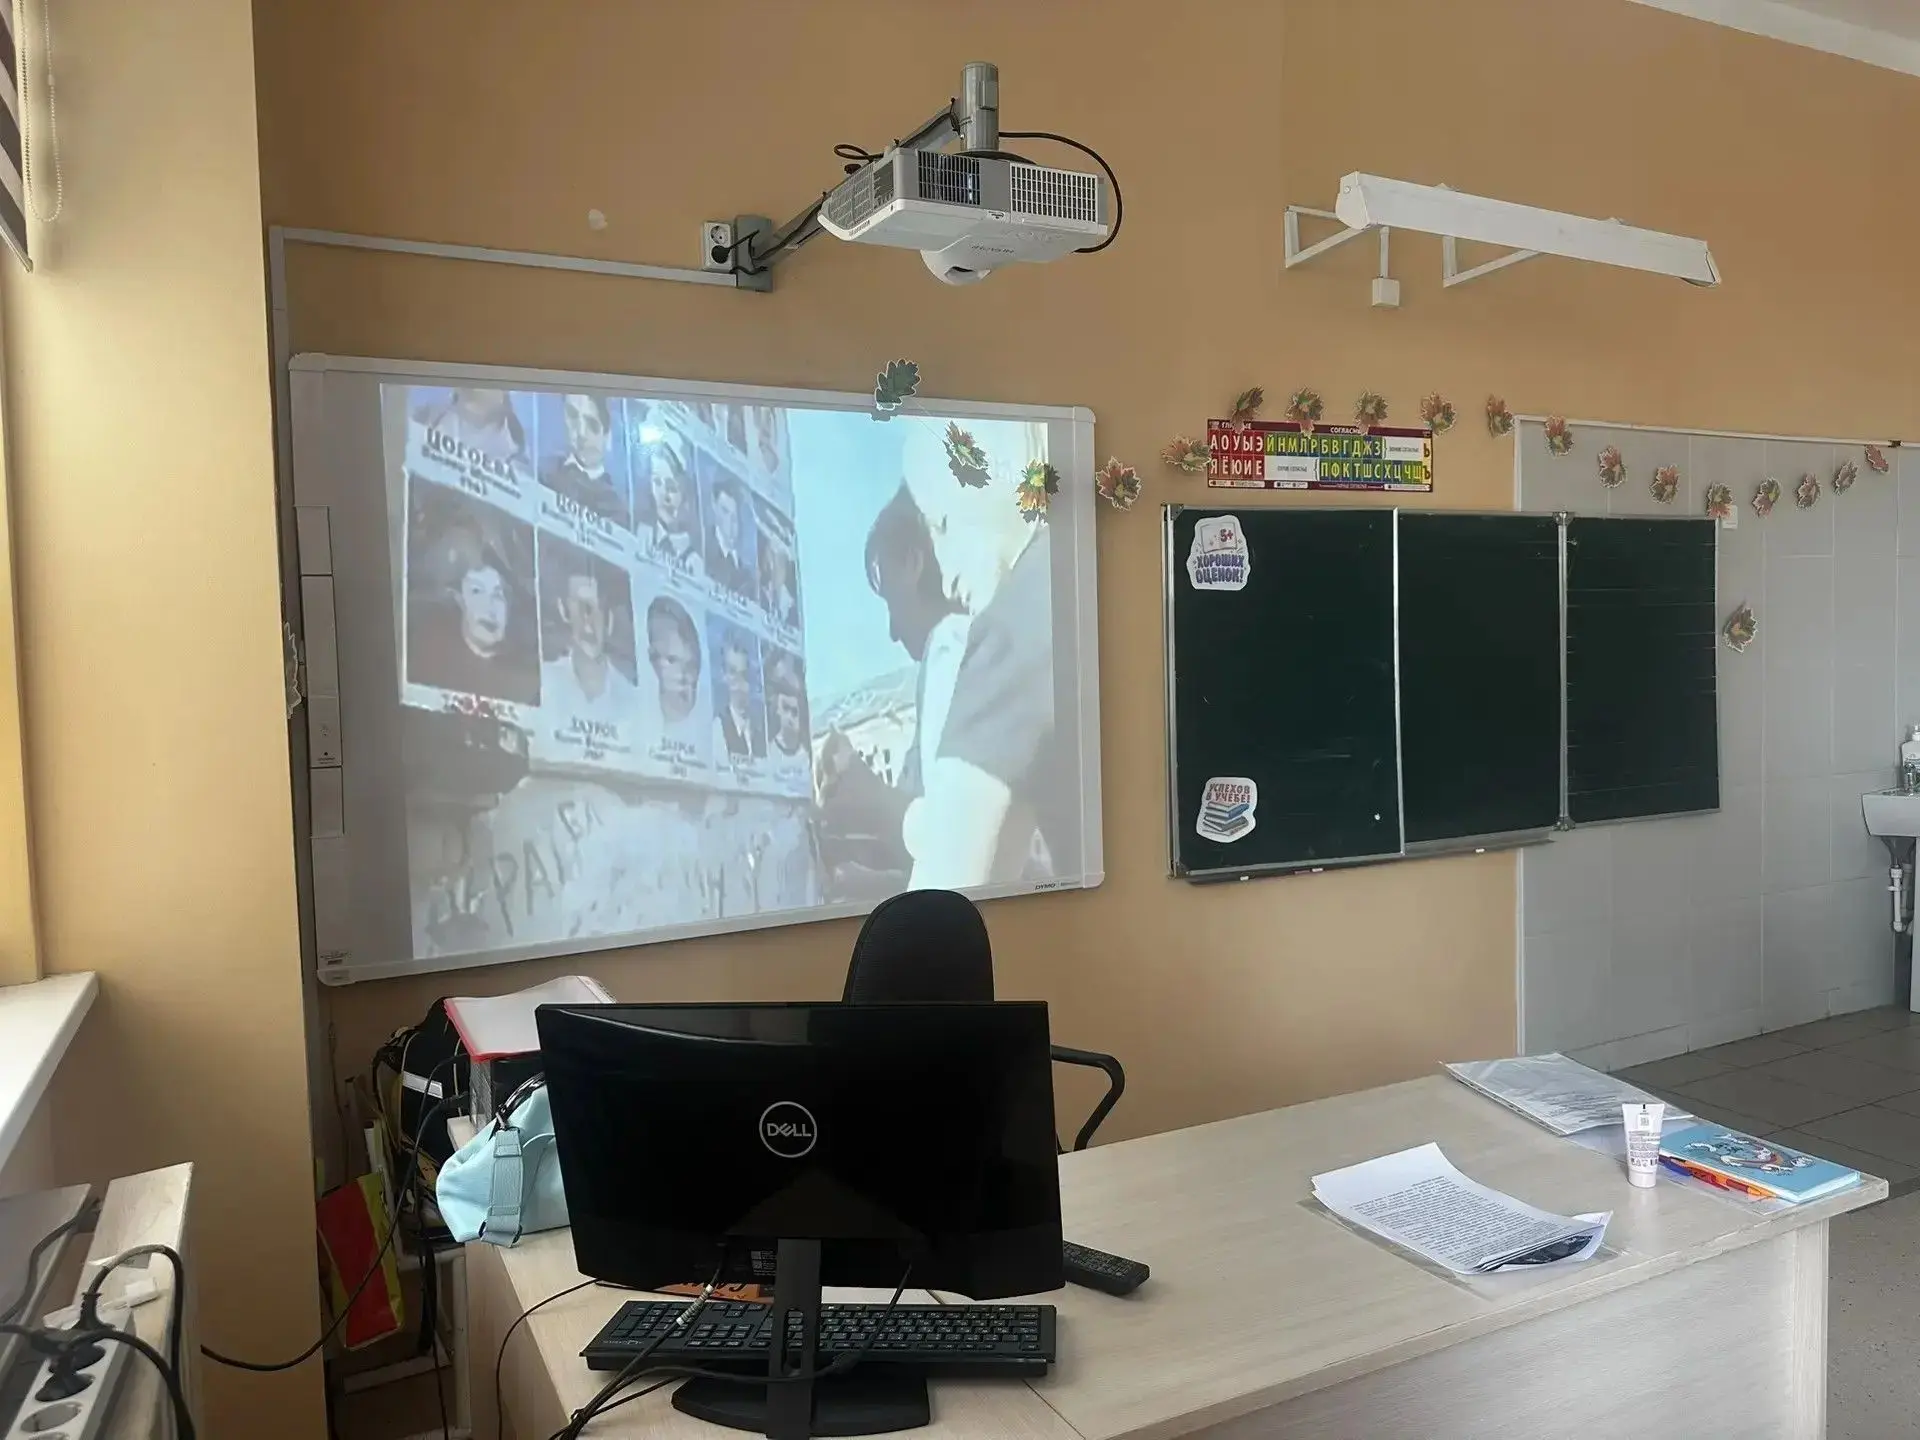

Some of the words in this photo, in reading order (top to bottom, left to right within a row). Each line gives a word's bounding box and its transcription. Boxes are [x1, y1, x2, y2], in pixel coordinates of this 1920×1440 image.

[1220, 528, 1234, 543] 5+
[1196, 553, 1245, 569] ХОРОШИХ
[1195, 567, 1245, 585] ОЦЕНОК!
[1209, 783, 1251, 795] УСПЕХОВ
[1206, 792, 1212, 801] В
[1215, 792, 1251, 803] УЧЕБЕ!
[766, 1122, 812, 1137] DELL
